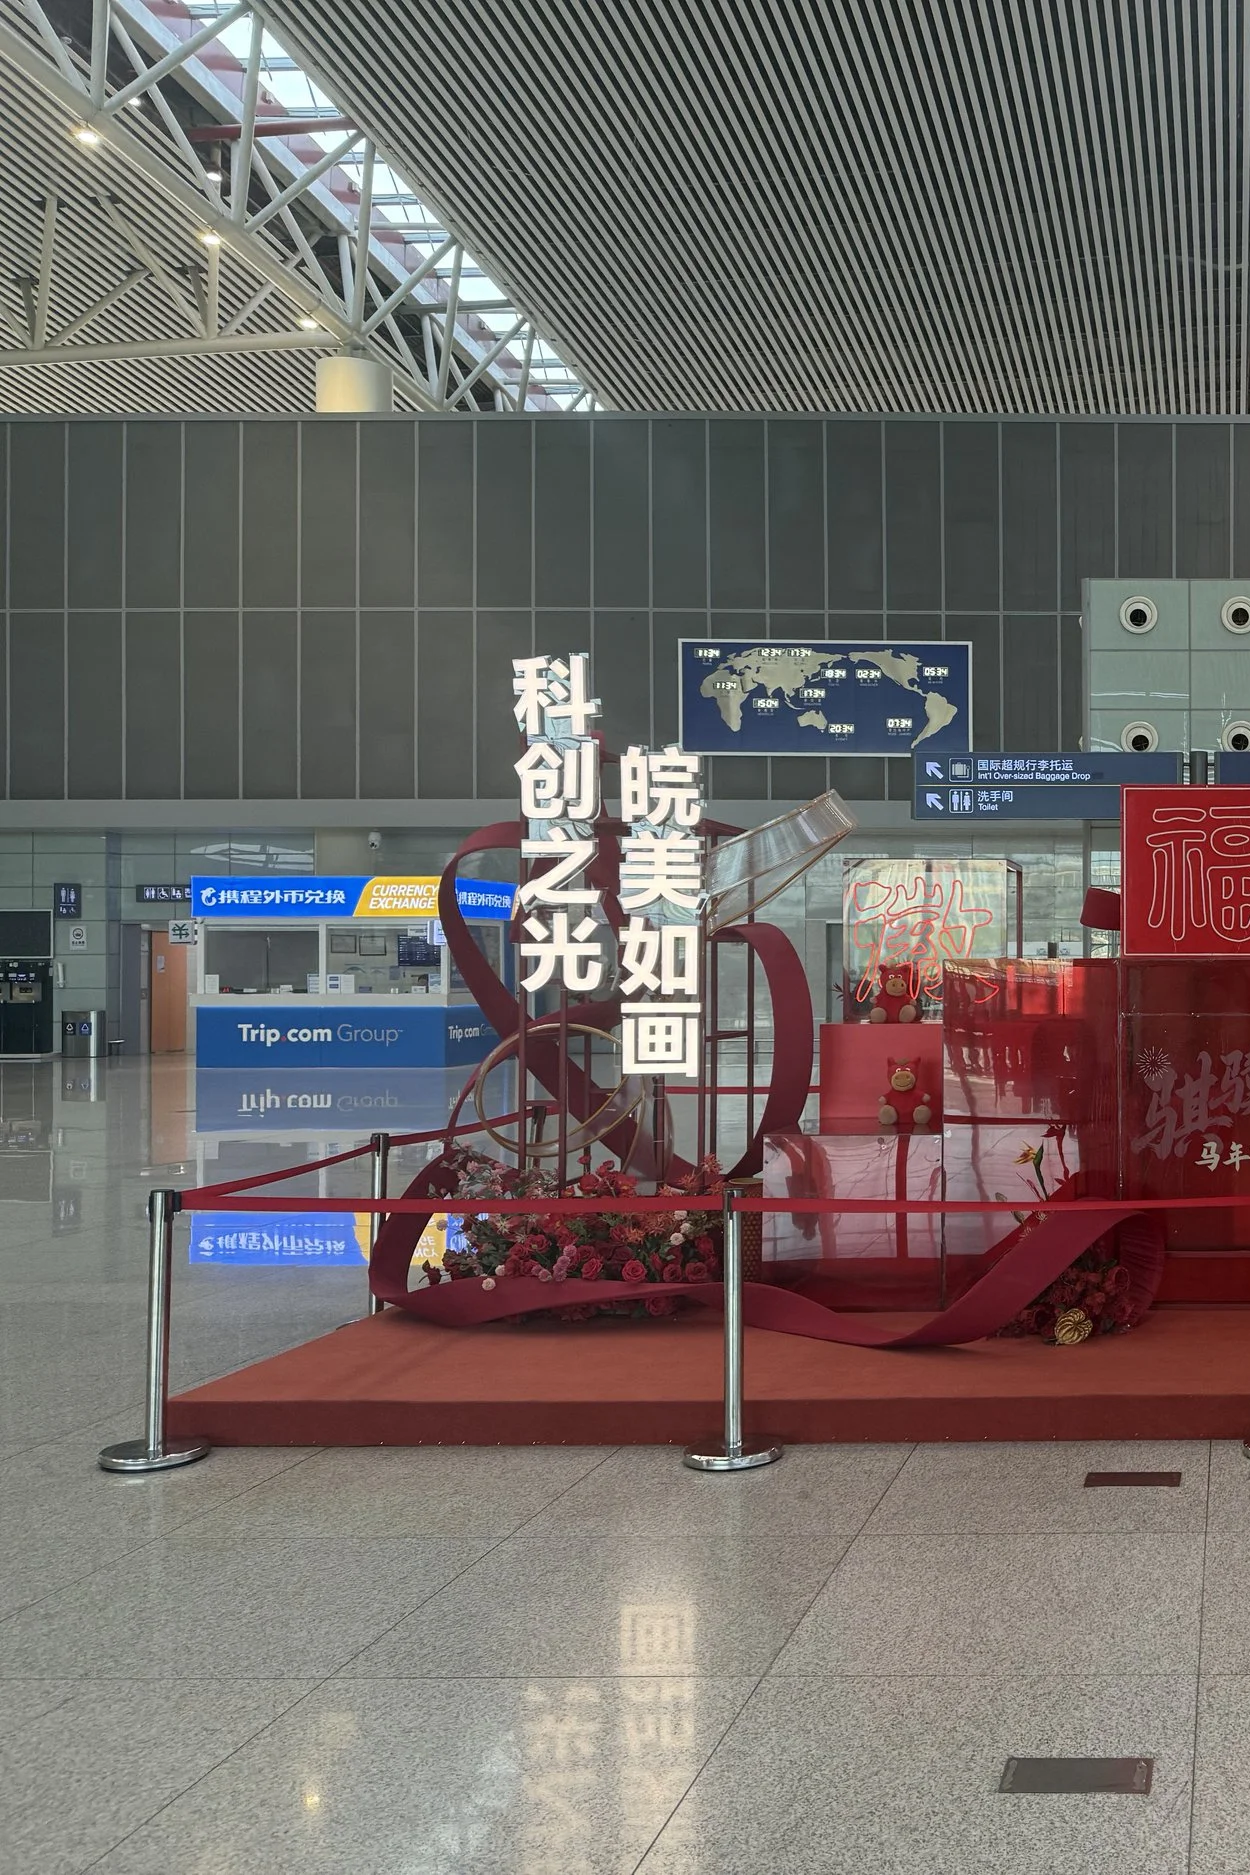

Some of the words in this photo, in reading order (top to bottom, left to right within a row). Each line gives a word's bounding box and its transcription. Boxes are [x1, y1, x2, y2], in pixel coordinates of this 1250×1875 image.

[977, 759, 1074, 771] 国际超规行李托运
[993, 771, 1034, 780] Over-sized
[1035, 771, 1070, 781] Baggage
[1071, 772, 1091, 781] Drop
[977, 790, 1014, 802] 洗手间
[979, 803, 998, 811] Toilet
[512, 653, 603, 993] 科创之光
[218, 889, 346, 904] 携程外币兑换
[371, 884, 439, 897] CURRENCY
[369, 897, 435, 910] EXCHANGE
[619, 745, 703, 1077] 皖美如画
[237, 1024, 332, 1047] Trip.com
[336, 1024, 399, 1047] Group
[448, 1025, 480, 1042] Trip.com
